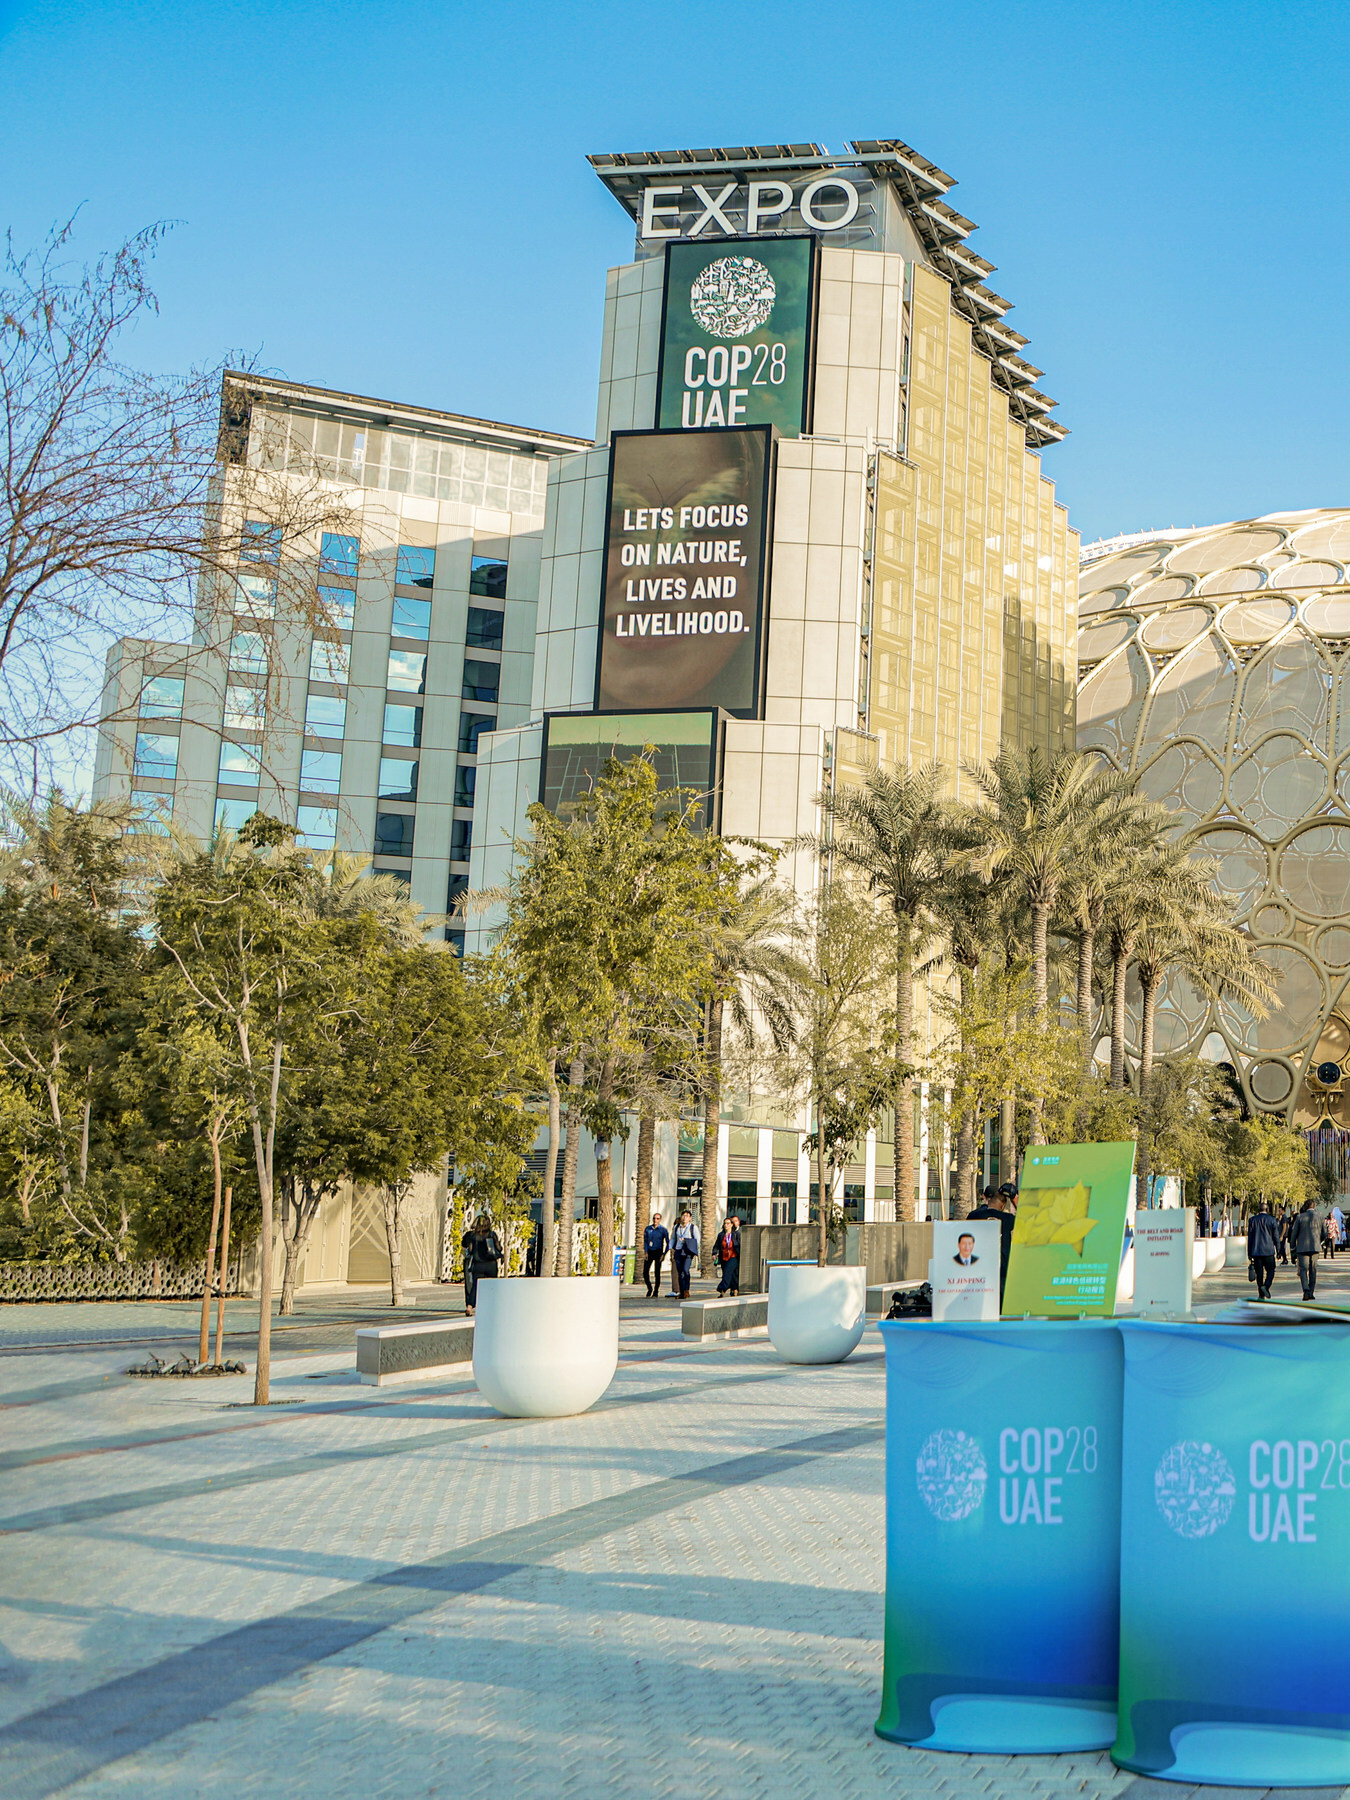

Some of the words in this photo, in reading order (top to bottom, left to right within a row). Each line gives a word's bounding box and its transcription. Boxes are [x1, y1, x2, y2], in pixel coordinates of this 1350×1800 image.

[641, 178, 860, 240] EXPO
[684, 343, 787, 388] COP28
[681, 389, 747, 428] UAE
[623, 507, 674, 532] LETS
[679, 503, 749, 529] FOCUS
[620, 543, 651, 567] ON
[656, 540, 748, 568] NATURE,
[626, 577, 687, 602] LIVES
[691, 575, 737, 599] AND
[615, 610, 750, 637] LIVELIHOOD.
[956, 1276, 986, 1284] JINPING
[999, 1426, 1098, 1475] COP28
[999, 1477, 1063, 1525] UAE
[1248, 1493, 1317, 1543] UAE
